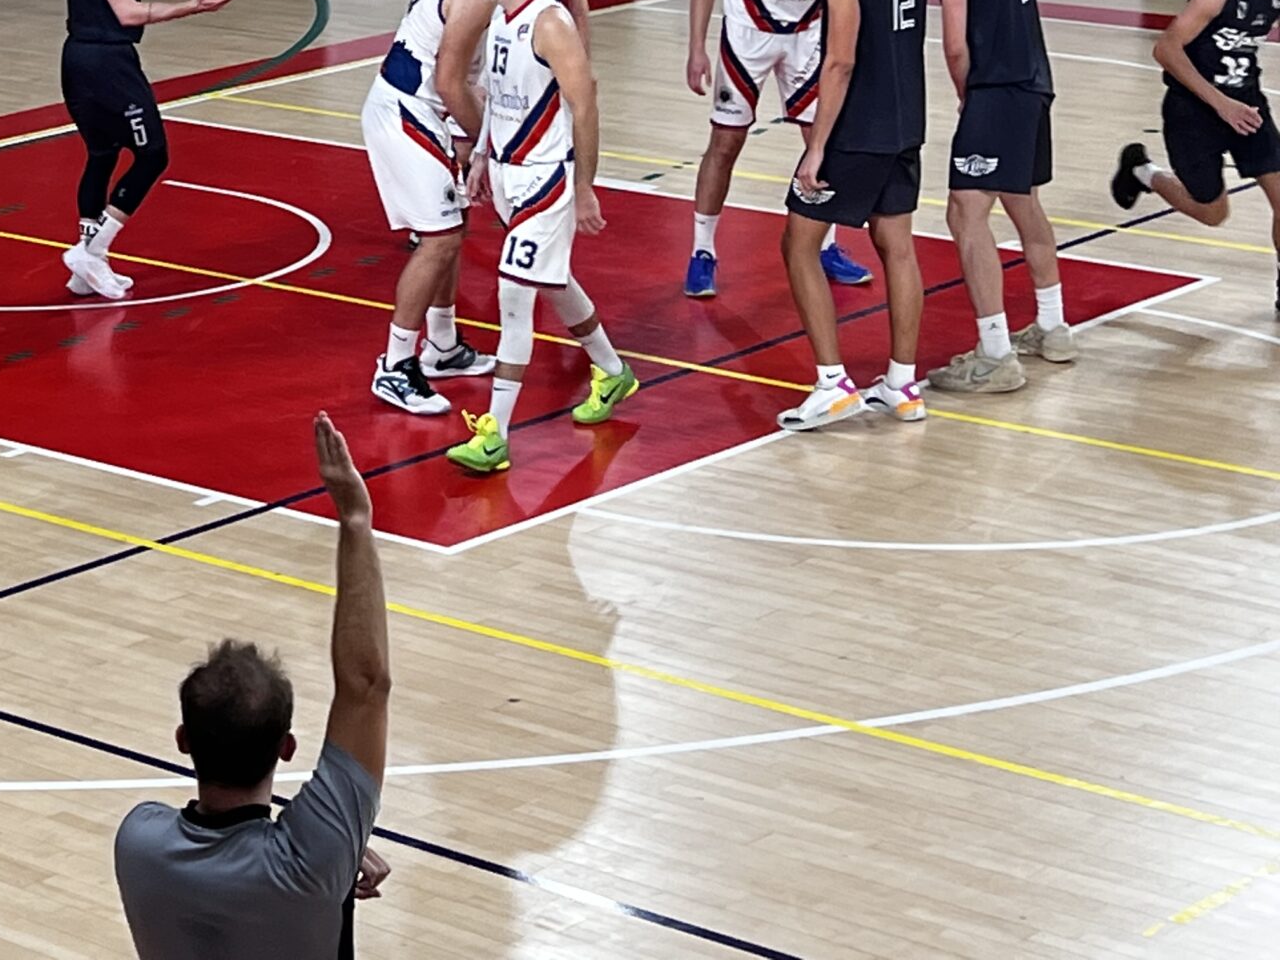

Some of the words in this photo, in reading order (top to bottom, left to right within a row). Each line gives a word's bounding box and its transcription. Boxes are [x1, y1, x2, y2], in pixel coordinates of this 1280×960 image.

[491, 44, 509, 75] 13
[129, 117, 148, 147] 5
[505, 235, 539, 270] 13
